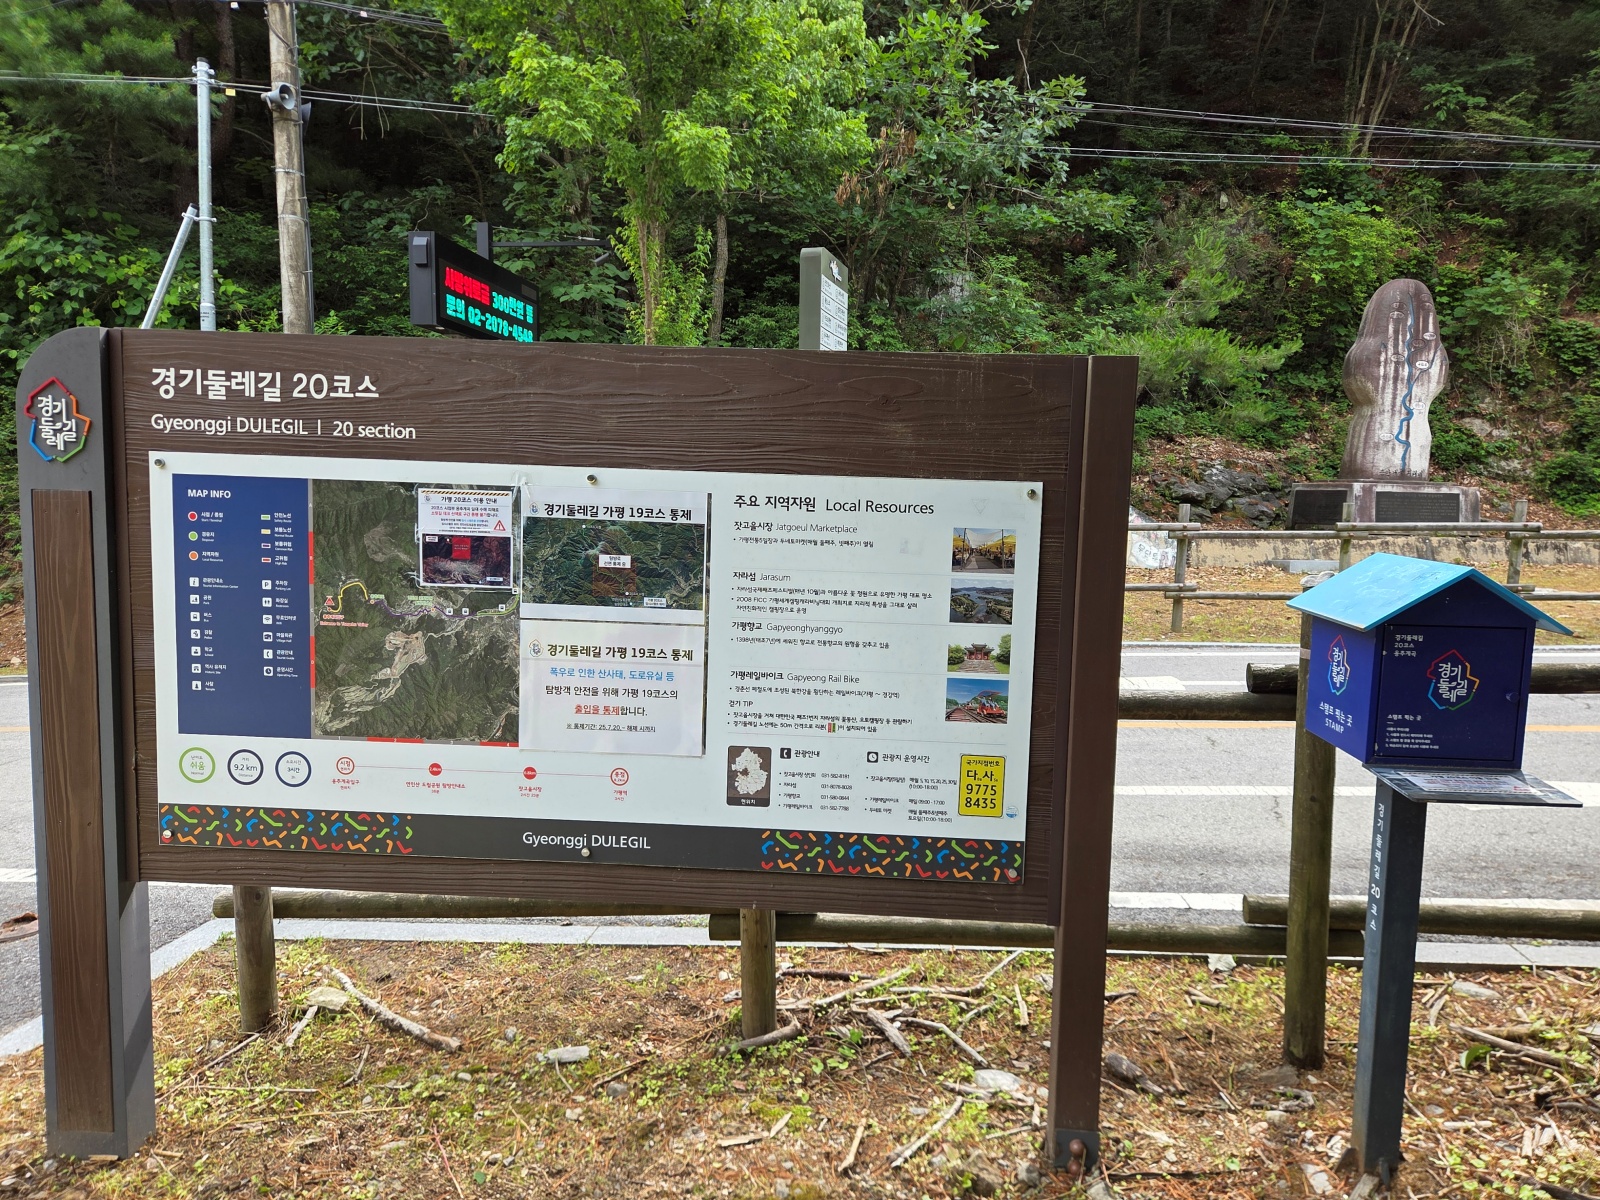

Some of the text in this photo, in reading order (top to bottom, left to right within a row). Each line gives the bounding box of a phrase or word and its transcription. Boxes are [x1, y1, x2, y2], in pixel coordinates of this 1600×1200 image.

[446, 294, 465, 320] 문의
[492, 292, 525, 320] 300만원
[151, 368, 379, 402] 경기둘레길 20코스
[151, 414, 416, 439] Gyeonggi DULEGIL 20 section
[188, 489, 231, 498] MAP INFO
[734, 495, 934, 514] 주요 지역자원 Local Resources
[544, 503, 692, 521] 경기둘레길 가평 19코스 통제
[734, 522, 857, 534] 잣고을시장 Jatgoeul Marketplace
[733, 572, 790, 581] 자라섬 Jarasum
[732, 622, 843, 635] 가평향교 Gapyeonghyanggyo
[547, 644, 693, 662] 경기둘레길 가평 19코스 통제
[550, 667, 674, 681] 폭우로 인한 산사태, 도로유실 등
[730, 671, 784, 680] 가평레일바이크
[787, 673, 826, 683] Gapyeong
[844, 675, 860, 683] Bike
[545, 686, 678, 700] 탐방객 안전을 위해 가평 19코스의
[575, 704, 647, 716] 출입을 통제합니다.
[1319, 701, 1352, 727] 스탬프 찍는 곳
[1325, 718, 1344, 734] STAMP
[794, 750, 820, 758] 관광안내
[904, 755, 930, 763] 운영시간
[190, 762, 205, 770] 쉬움
[967, 770, 978, 781] 다
[982, 771, 994, 782] 사
[966, 784, 997, 796] 9775
[965, 797, 996, 809] 8435
[522, 832, 651, 849] Gyeonggi DULEGIL
